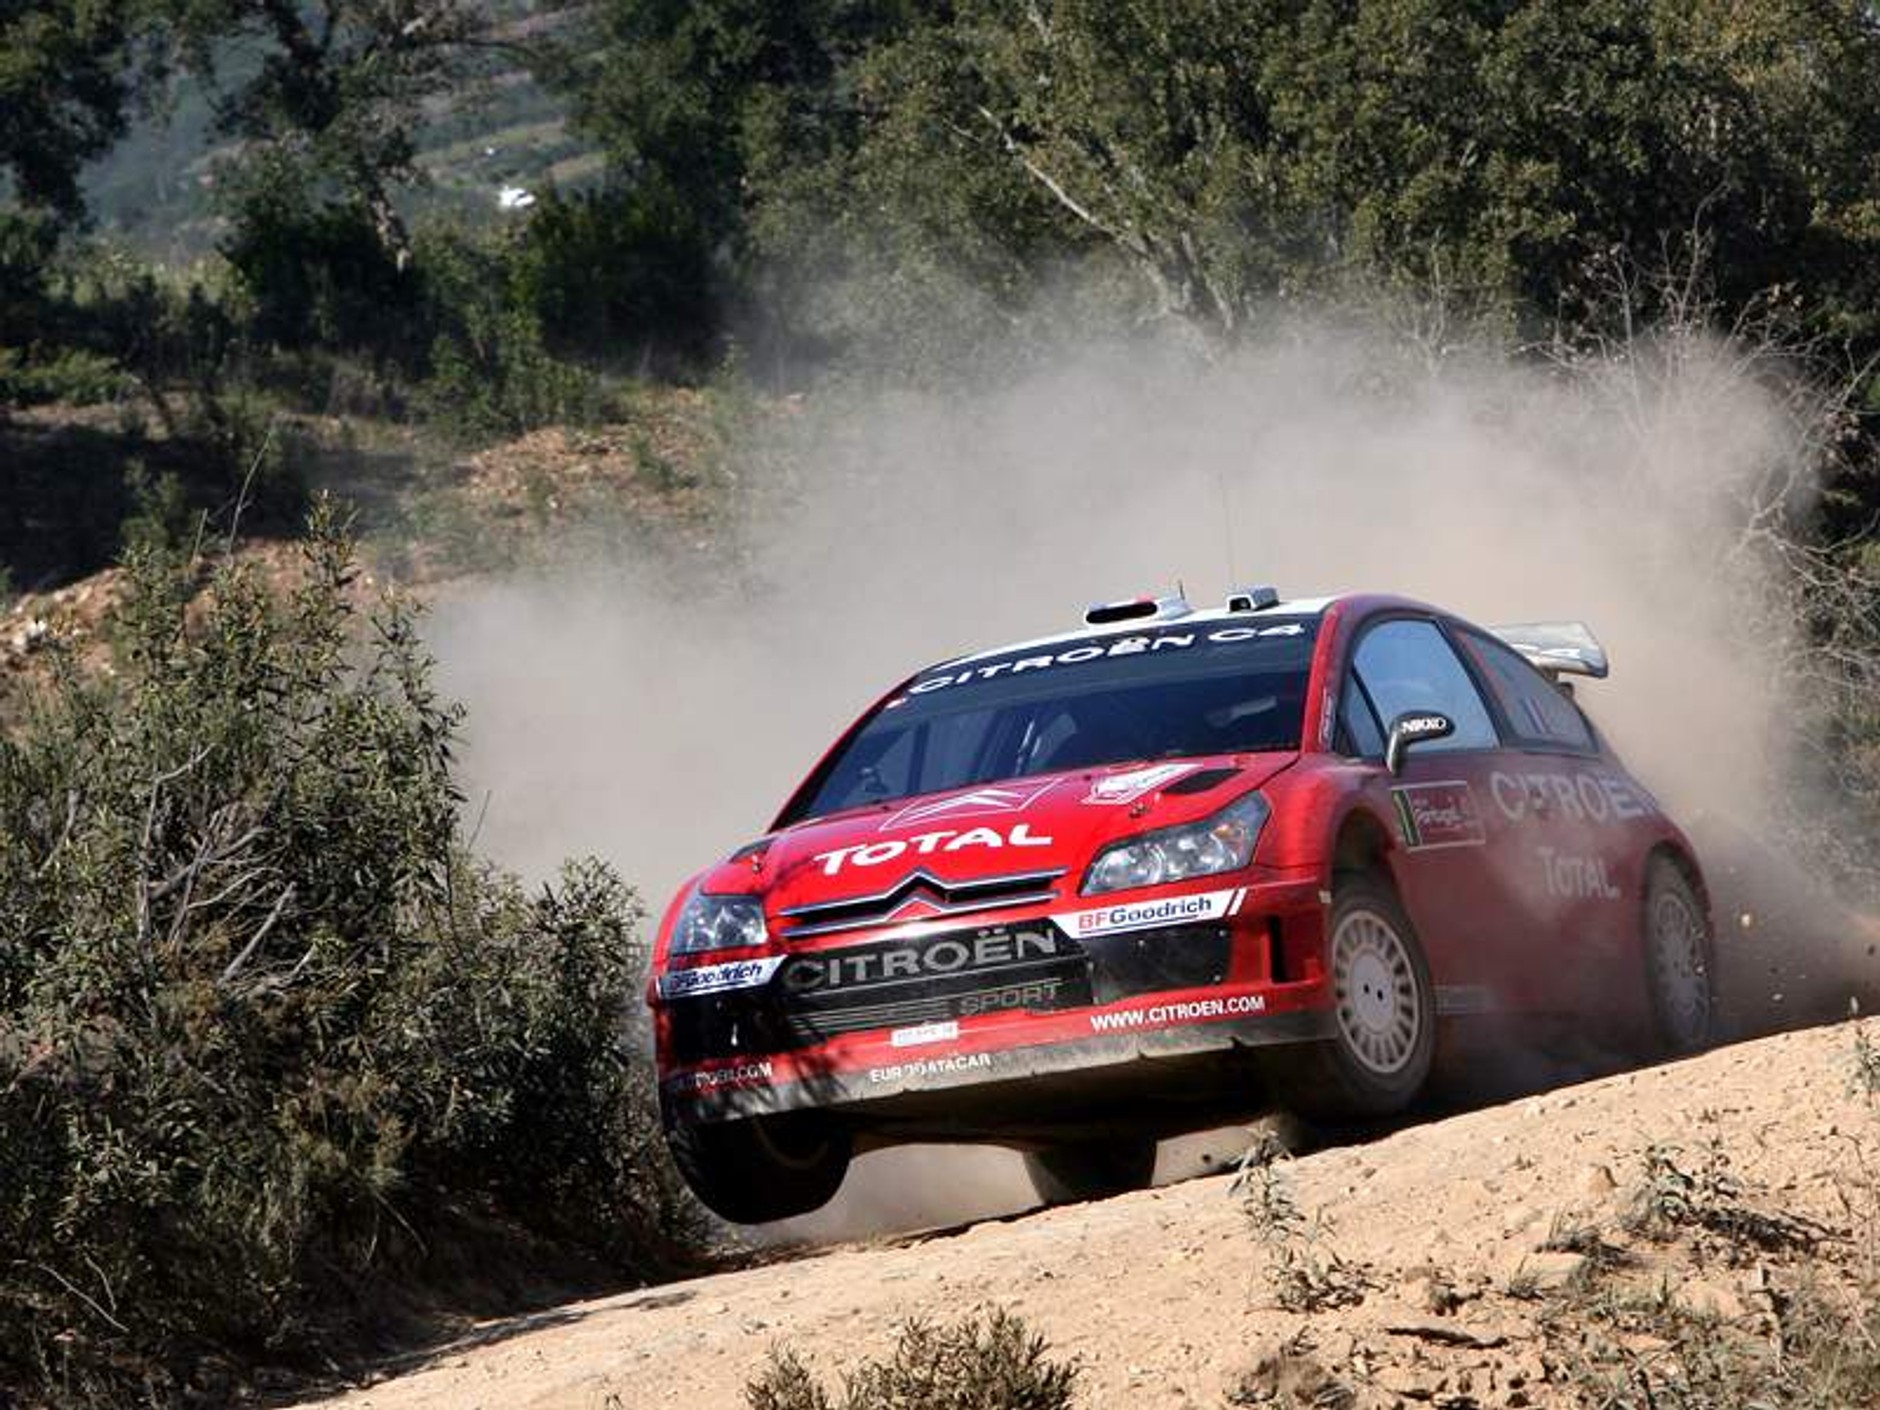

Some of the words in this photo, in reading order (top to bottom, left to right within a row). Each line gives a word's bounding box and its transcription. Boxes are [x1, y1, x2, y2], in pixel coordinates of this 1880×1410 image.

[1208, 624, 1305, 641] C4
[1401, 717, 1447, 734] NIKKO
[813, 824, 1053, 875] TOTAL
[1078, 897, 1212, 930] BFGoodrich
[784, 928, 1057, 990] CITROËN
[959, 981, 1064, 1015] SPORT
[1090, 996, 1266, 1032] WWW.CITROEN.COM
